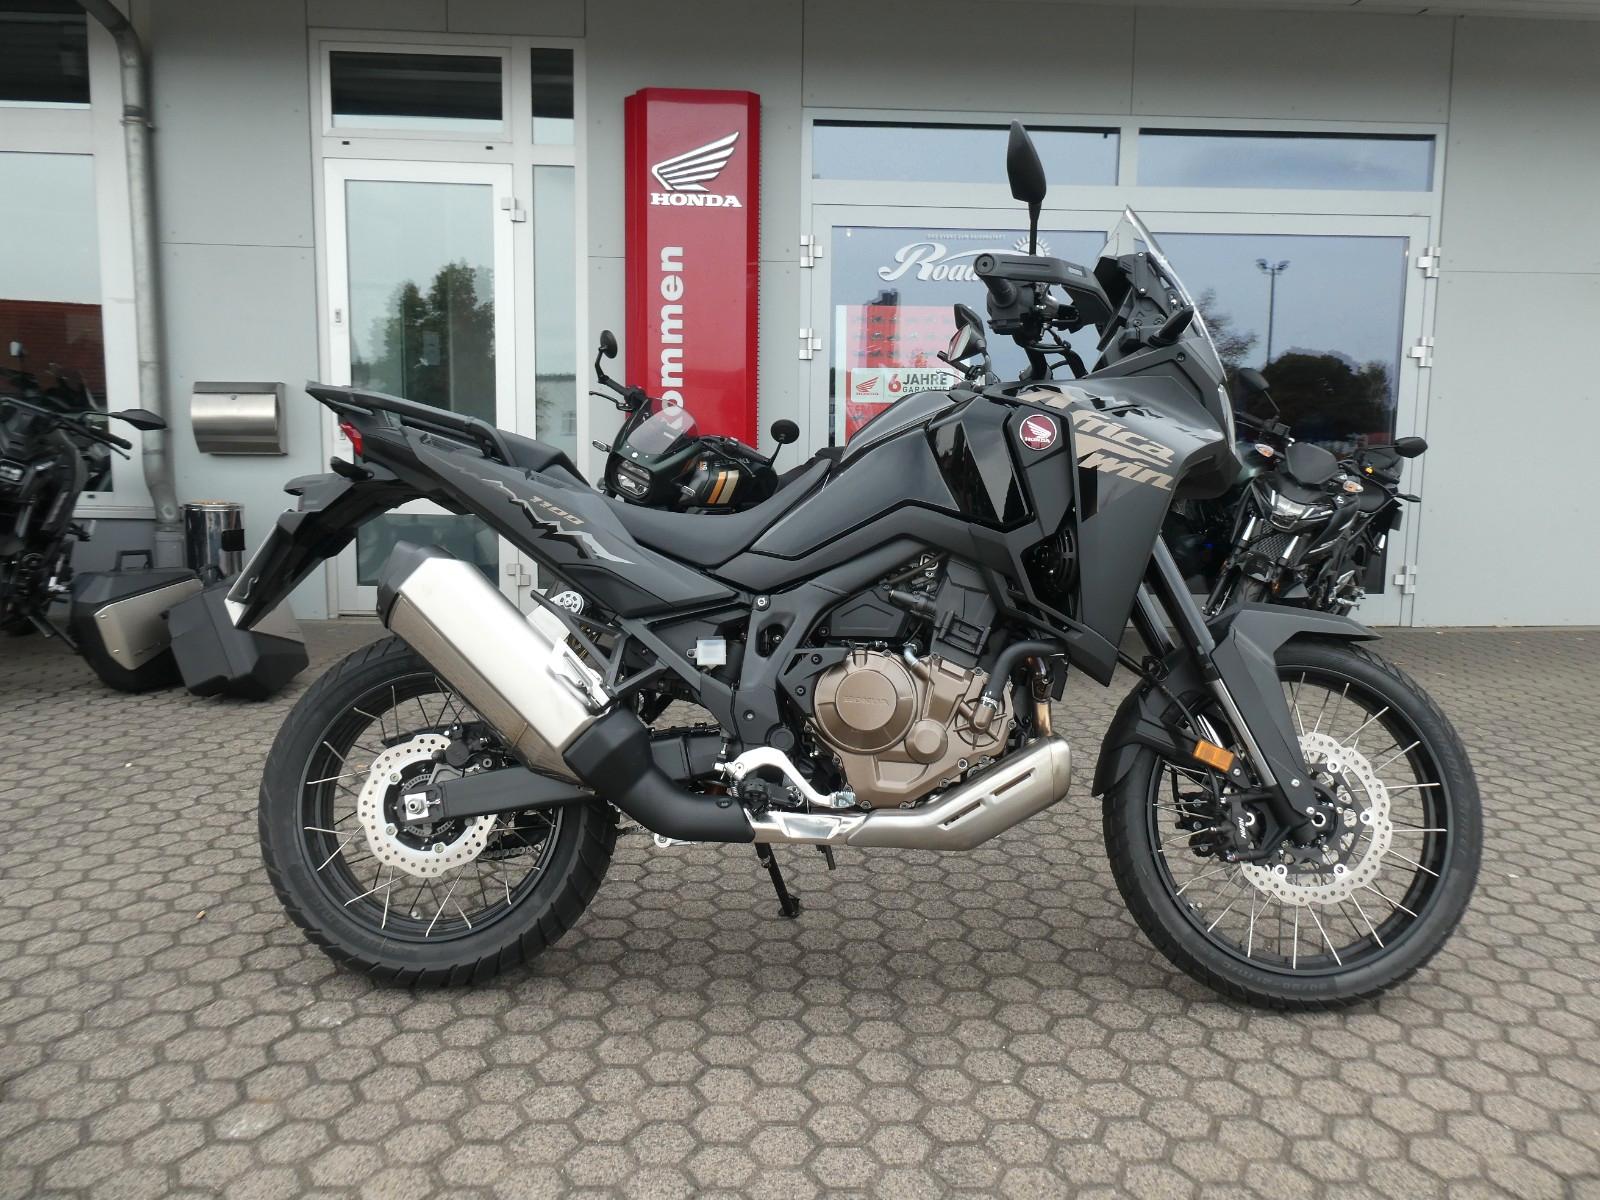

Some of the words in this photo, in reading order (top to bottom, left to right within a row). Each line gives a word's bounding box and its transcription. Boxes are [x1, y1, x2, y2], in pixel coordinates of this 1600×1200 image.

[650, 192, 743, 208] HONDA
[888, 373, 902, 393] 6
[902, 373, 948, 386] JAHRE
[1024, 436, 1051, 444] HONDA
[530, 495, 585, 525] 1100
